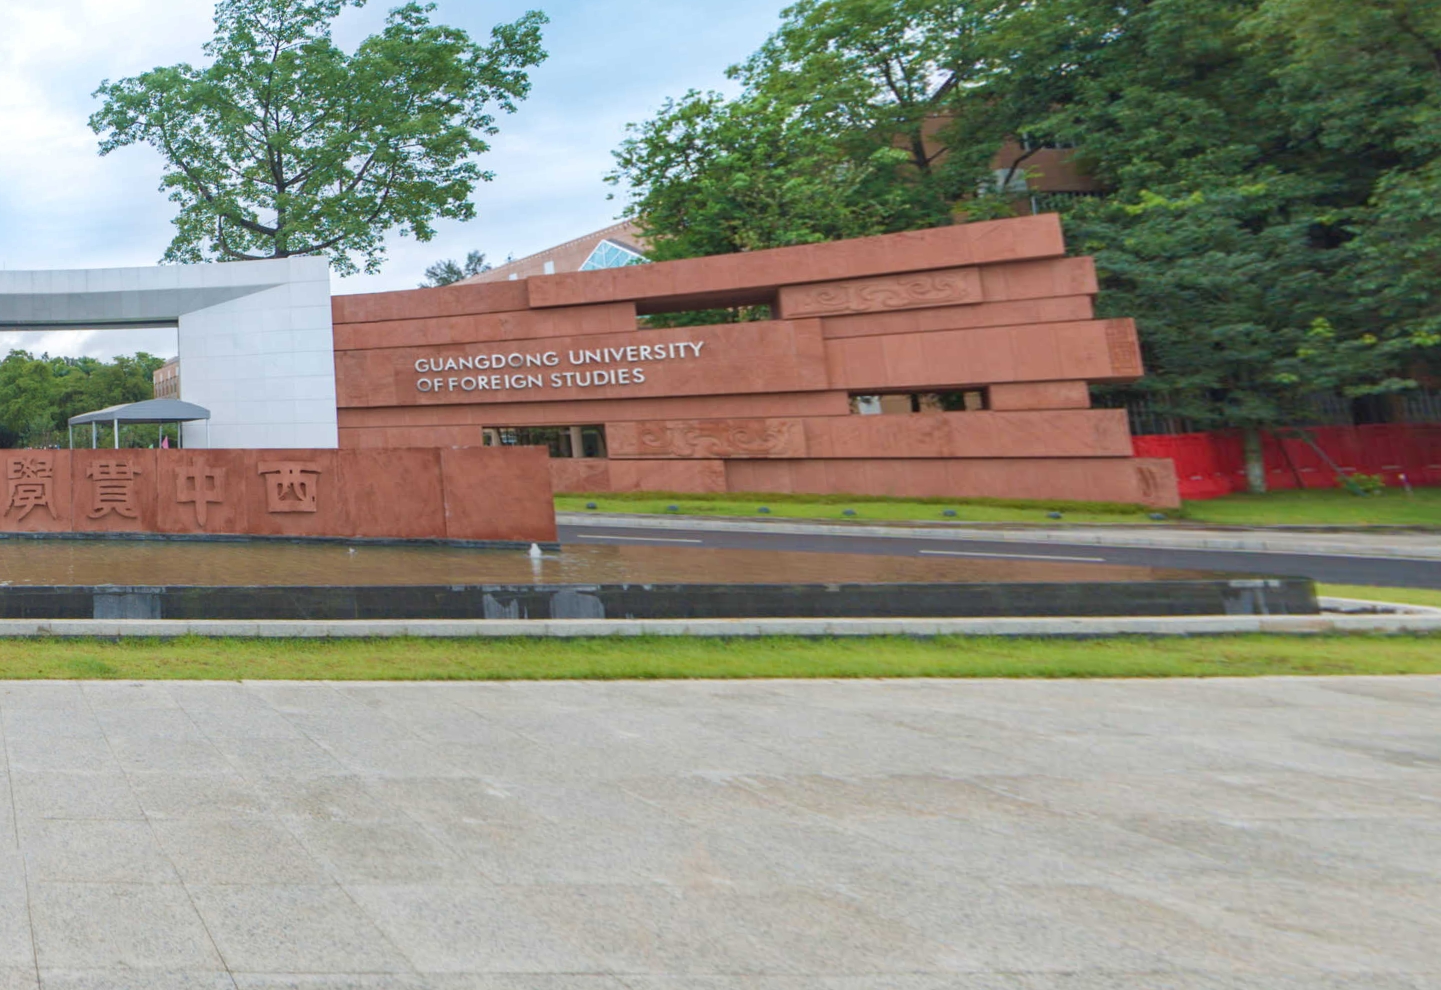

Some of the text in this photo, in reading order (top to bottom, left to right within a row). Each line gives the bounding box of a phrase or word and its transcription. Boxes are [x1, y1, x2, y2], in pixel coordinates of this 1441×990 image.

[414, 341, 705, 373] GUANGDONG UNIVERSITY
[416, 367, 646, 392] OF FOREIGN STUDIES
